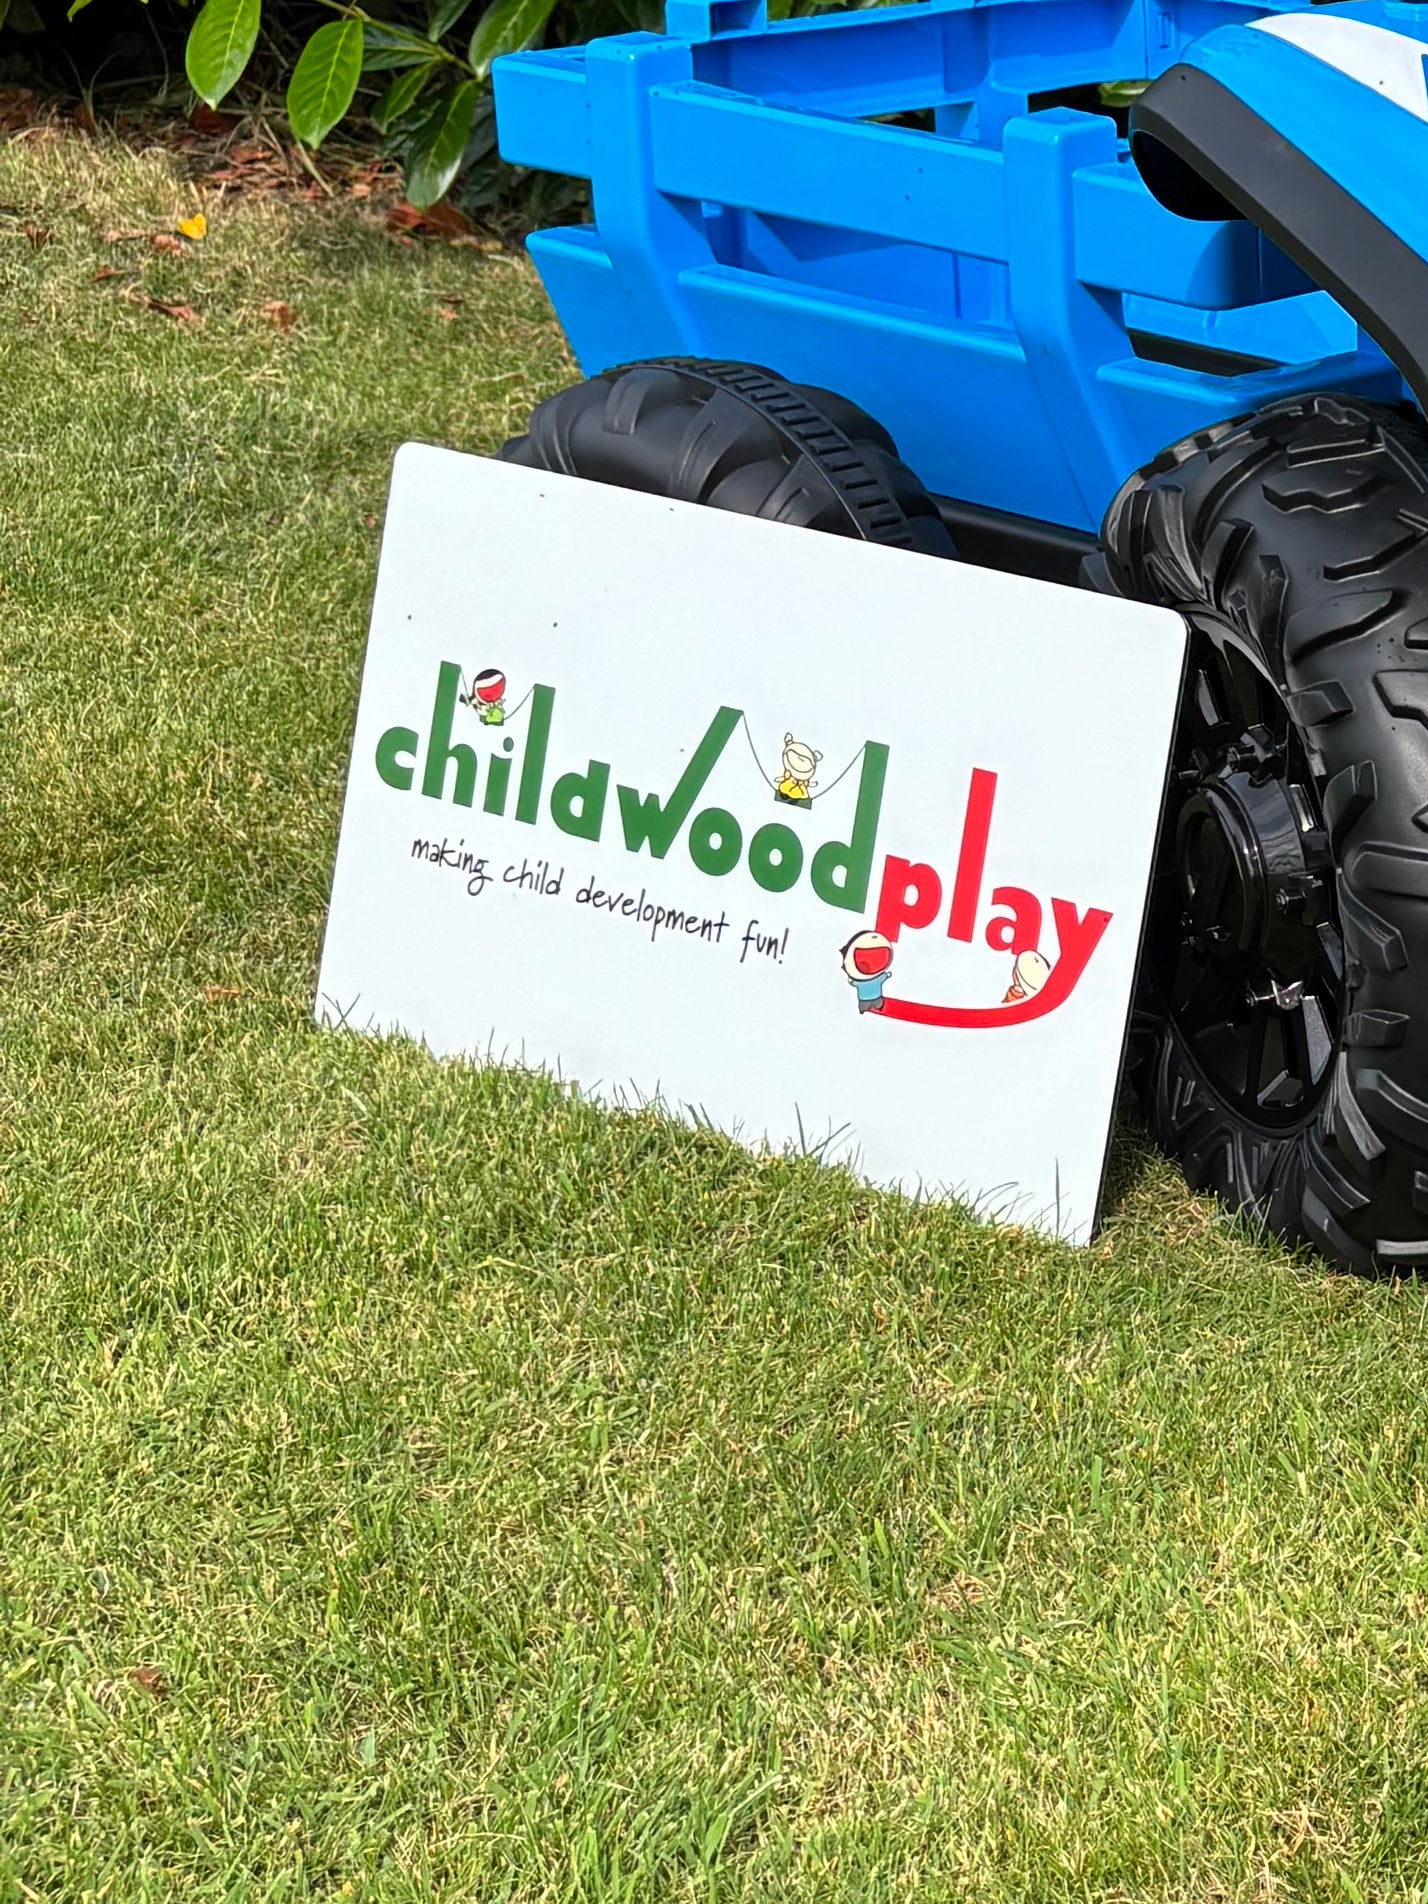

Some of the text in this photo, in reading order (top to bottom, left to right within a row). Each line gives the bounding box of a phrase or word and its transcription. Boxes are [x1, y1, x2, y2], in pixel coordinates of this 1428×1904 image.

[410, 837, 790, 965] making child development fun!
